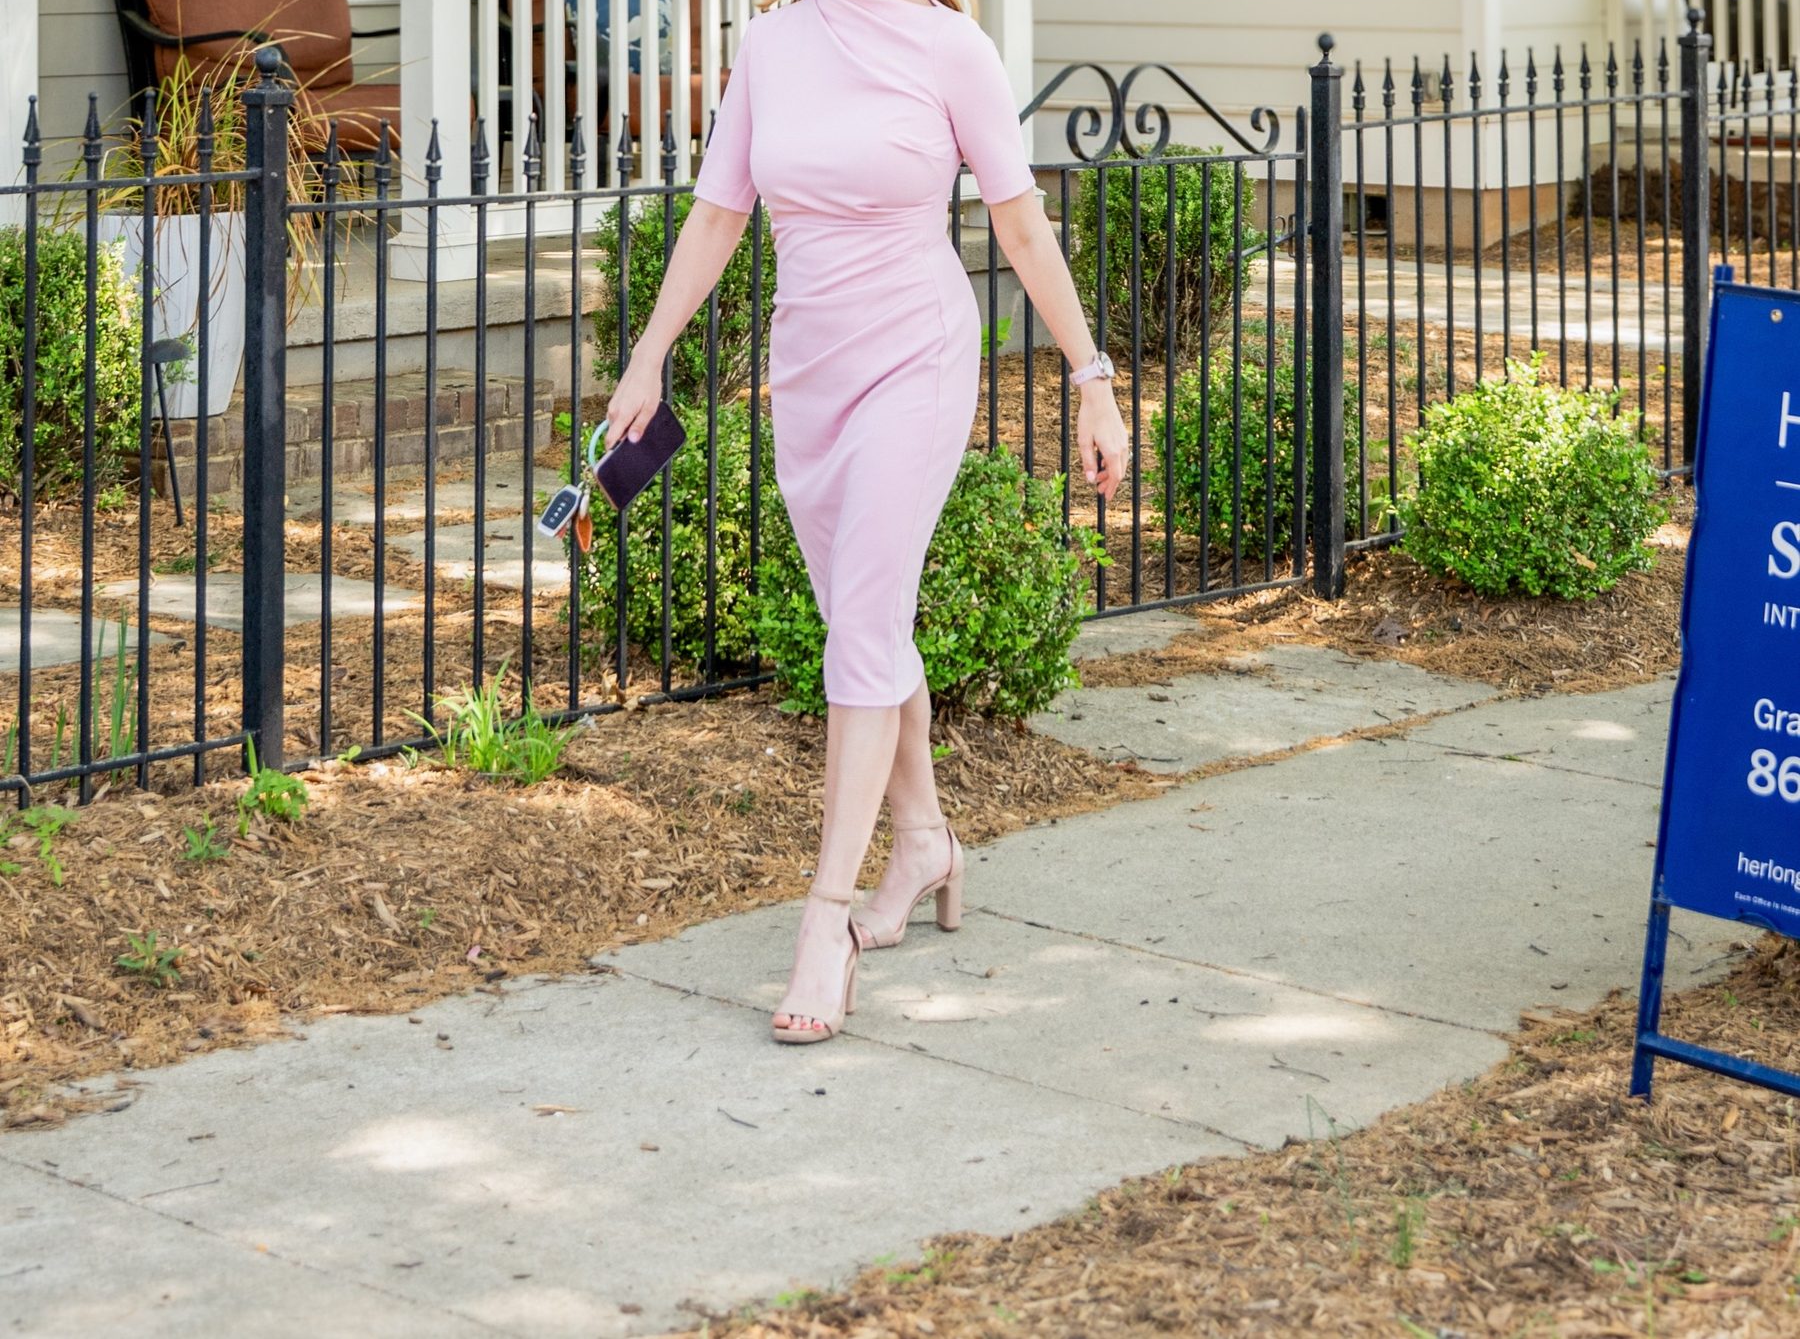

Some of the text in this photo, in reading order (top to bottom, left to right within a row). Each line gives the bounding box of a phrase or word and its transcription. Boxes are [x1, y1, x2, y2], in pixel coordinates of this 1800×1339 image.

[1768, 521, 1800, 578] S
[1764, 602, 1800, 629] INT
[1754, 698, 1800, 737] Gra
[1747, 749, 1800, 803] 86
[1738, 851, 1800, 893] herlong
[1734, 891, 1751, 901] Each
[1752, 896, 1772, 907] Office
